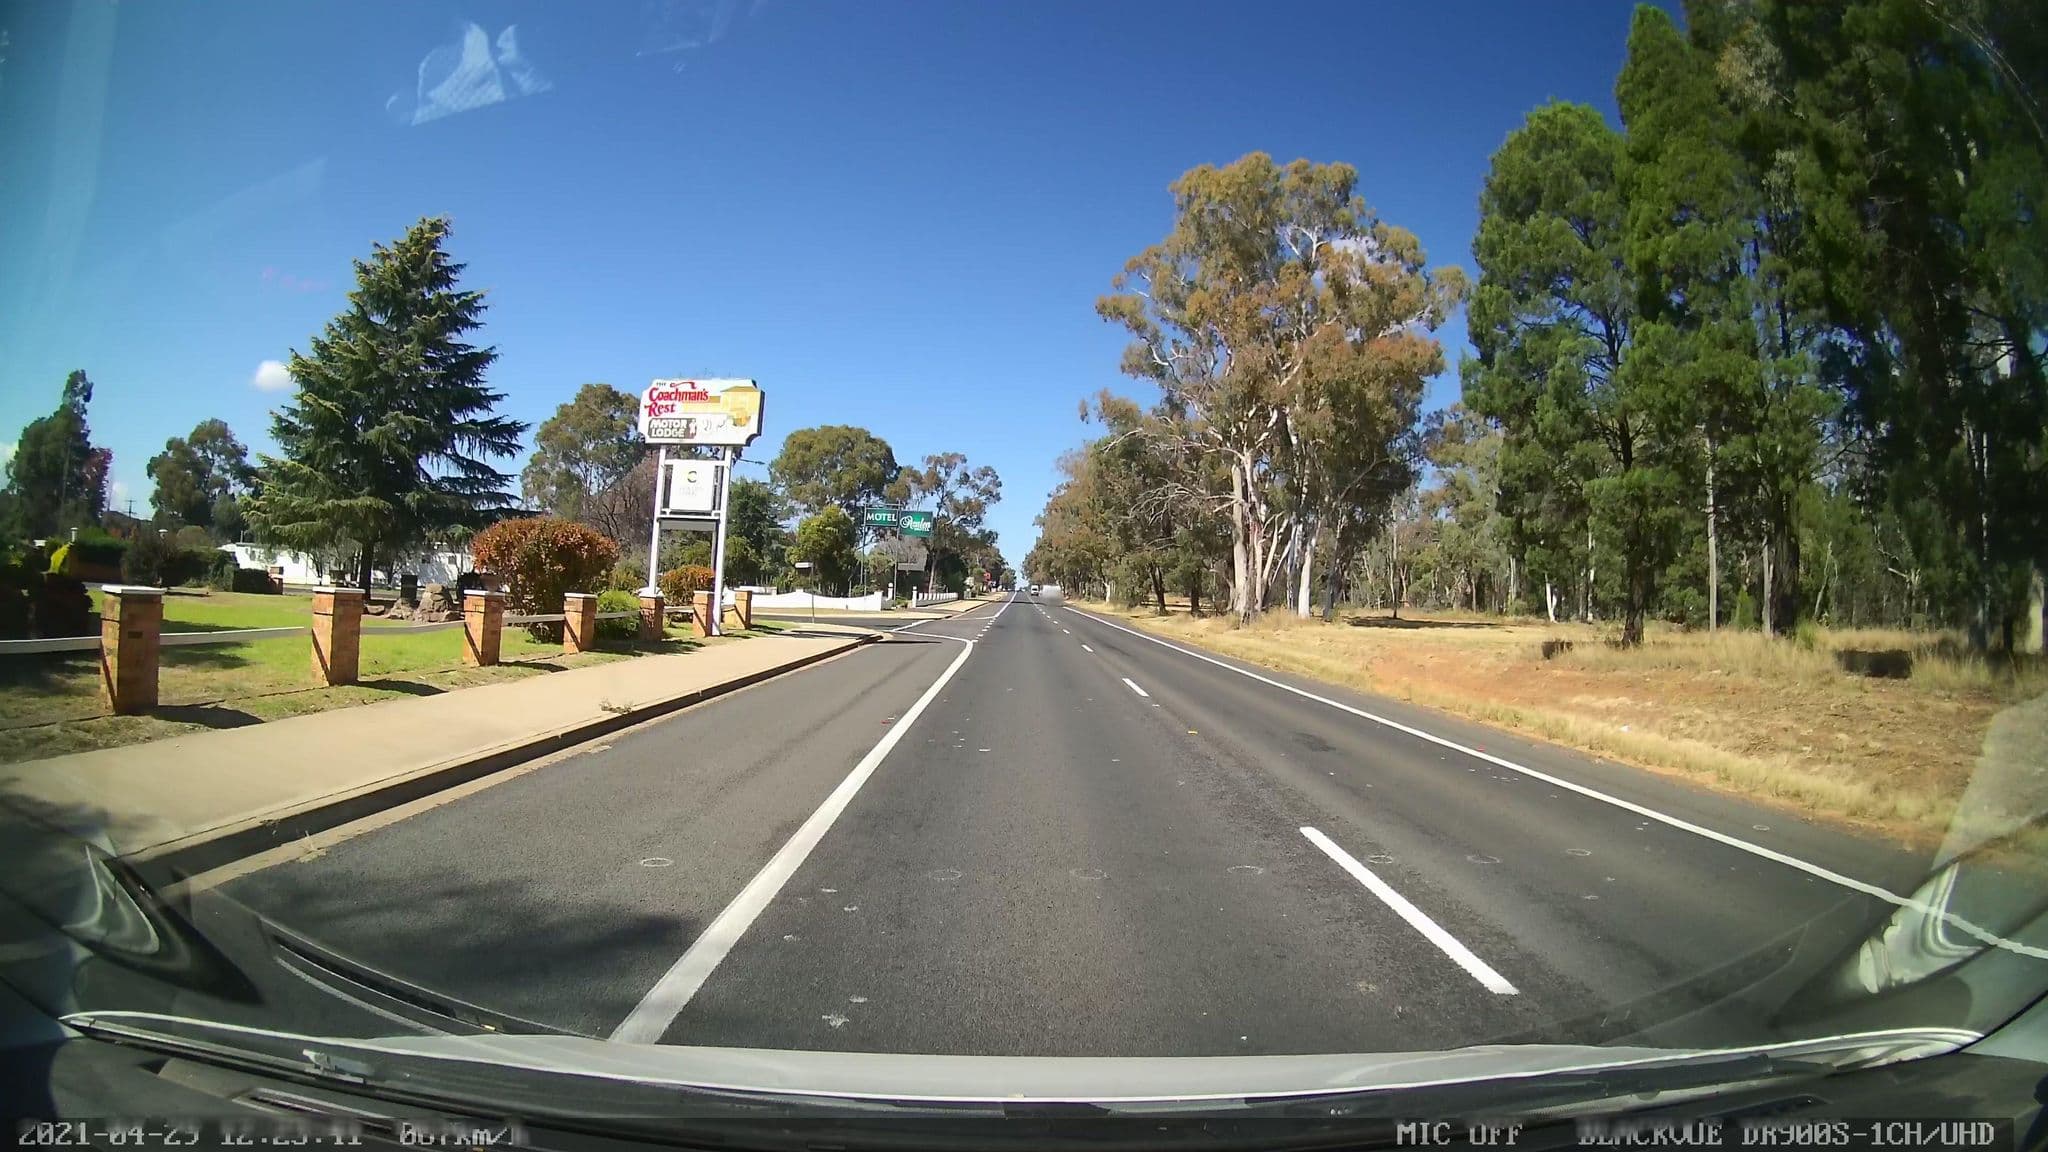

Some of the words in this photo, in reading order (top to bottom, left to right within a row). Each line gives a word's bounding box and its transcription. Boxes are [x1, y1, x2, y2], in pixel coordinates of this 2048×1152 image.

[648, 387, 709, 402] Coachman's
[644, 402, 675, 417] Rest
[650, 419, 687, 429] MOTOR
[651, 428, 685, 438] LODGE
[866, 513, 897, 522] MOTEL
